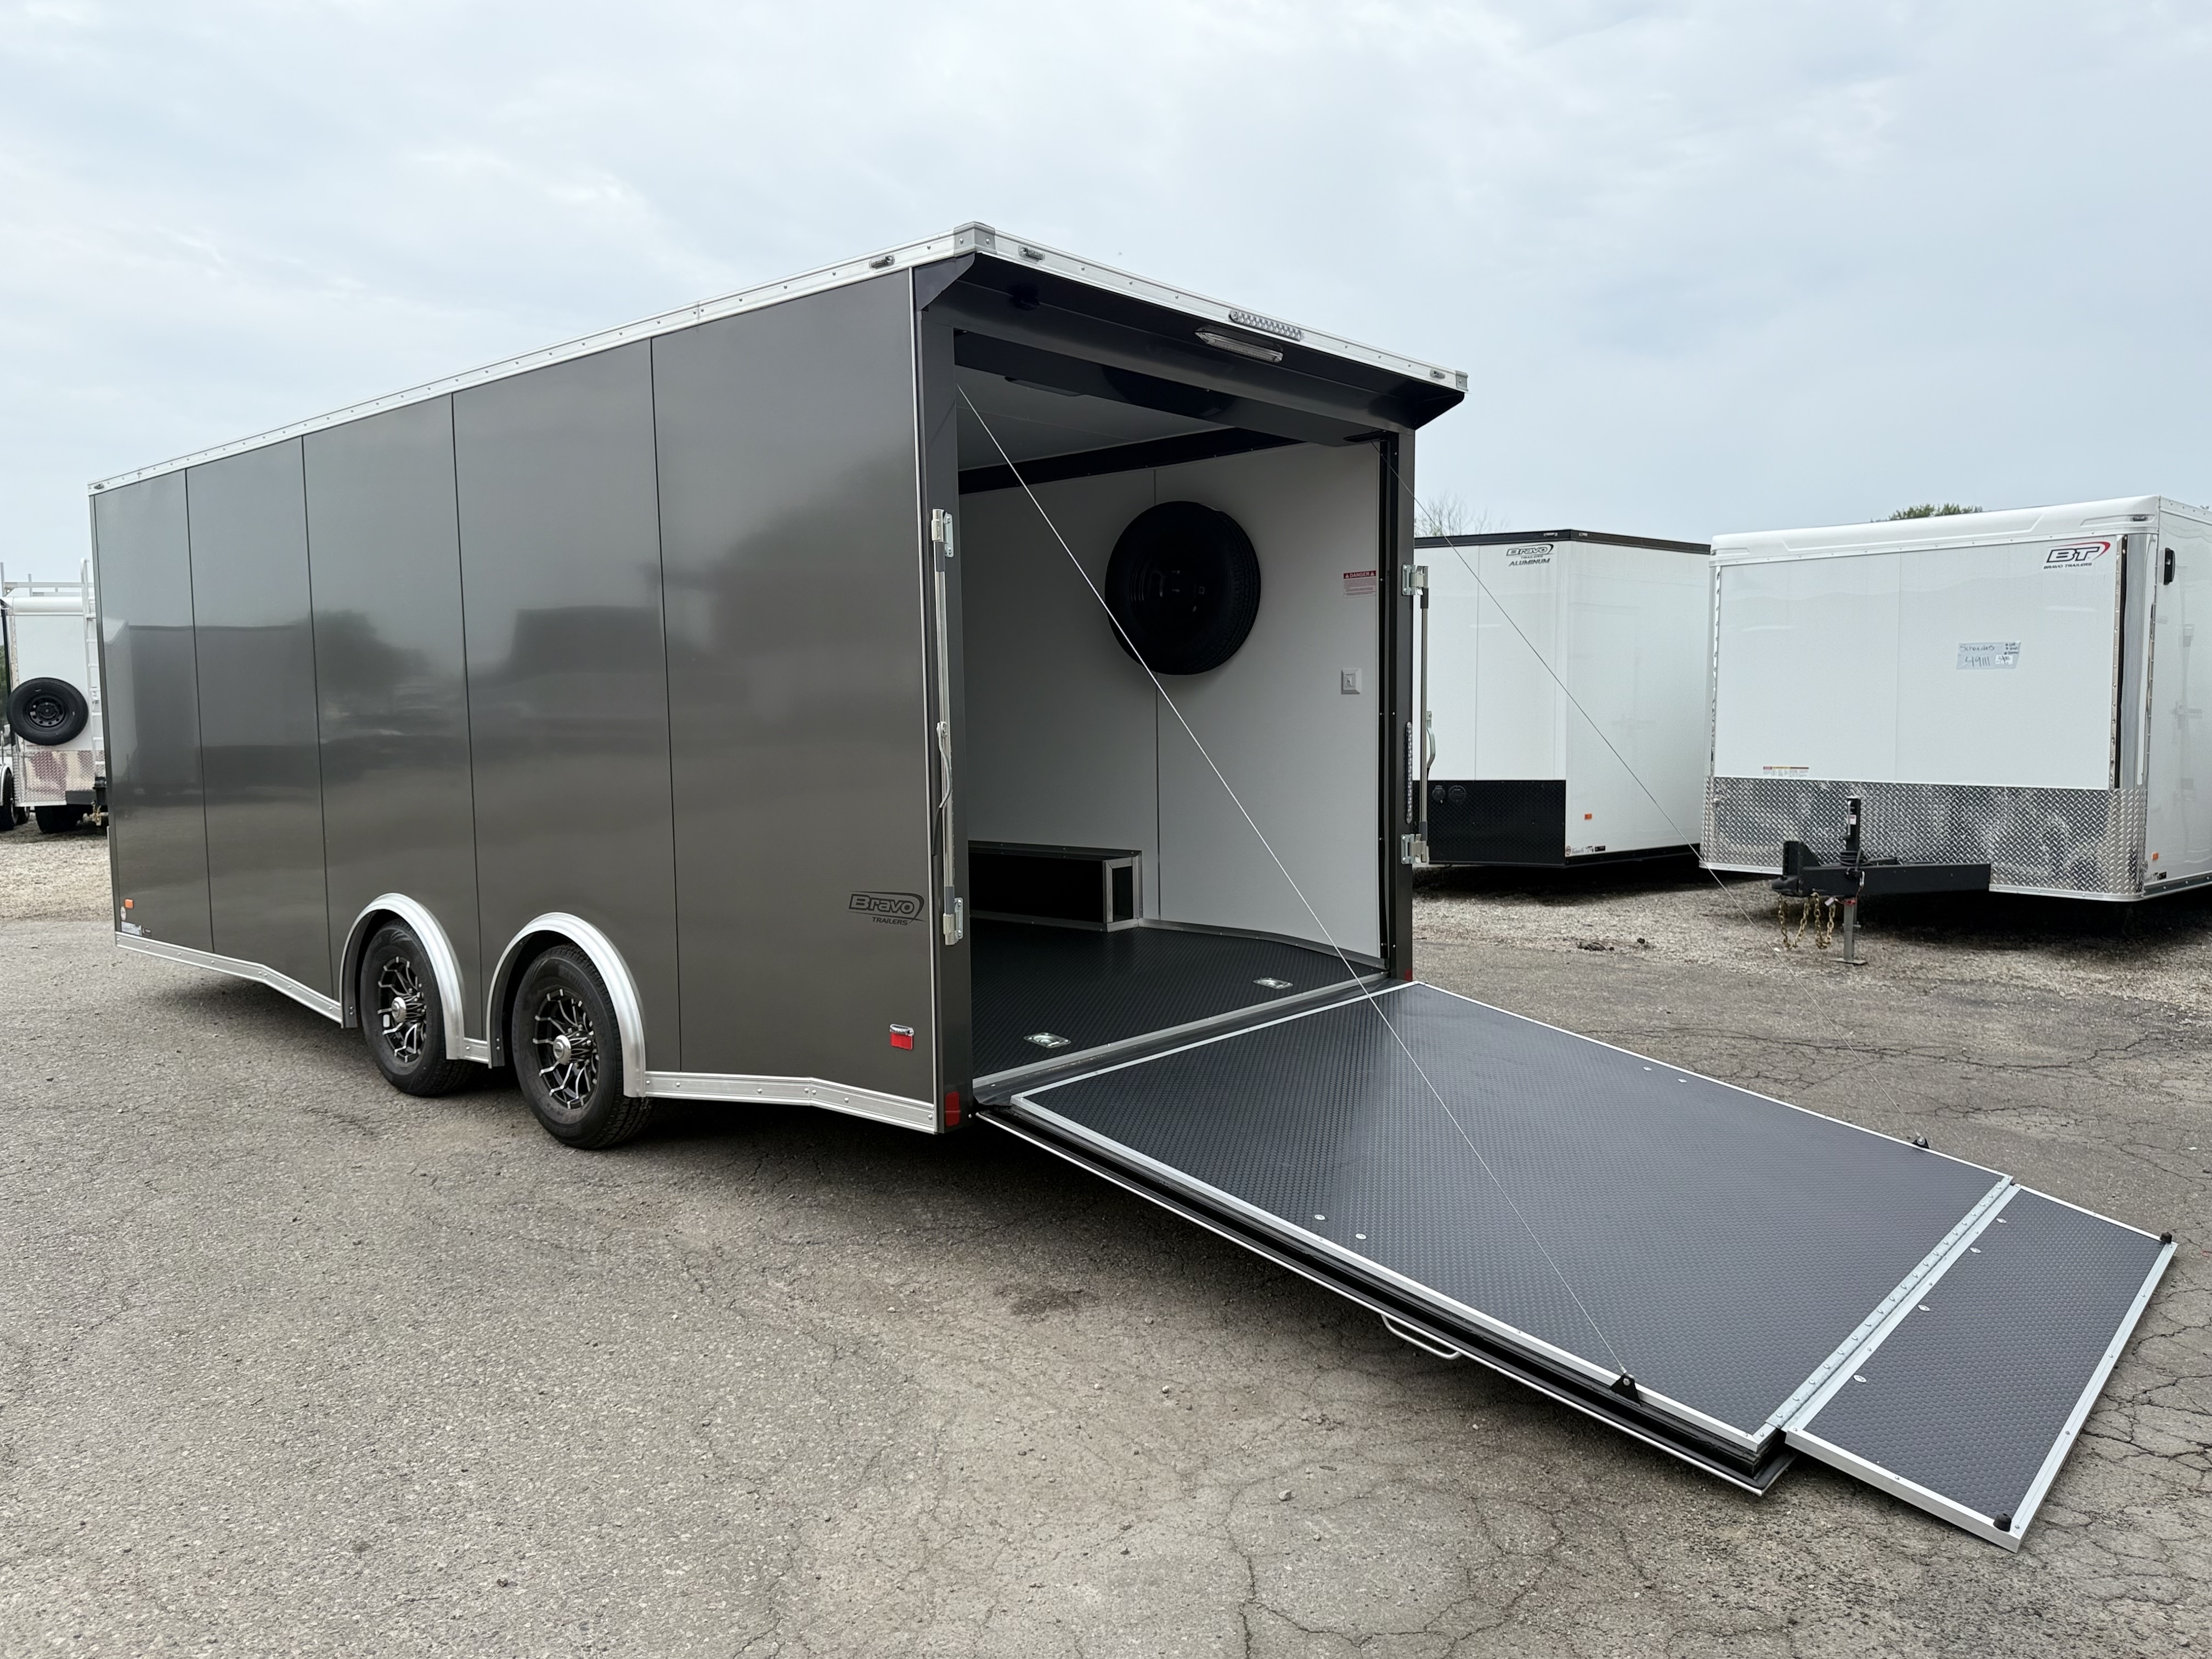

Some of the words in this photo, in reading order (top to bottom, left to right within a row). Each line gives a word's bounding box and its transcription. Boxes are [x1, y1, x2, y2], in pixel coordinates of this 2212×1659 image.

[1506, 547, 1548, 556] Bravo
[2046, 546, 2101, 563] BT
[1508, 558, 1550, 567] ALUMINUM
[1965, 656, 1990, 668] 49111
[849, 894, 915, 914] Bravo
[872, 917, 909, 926] TRAILERS
